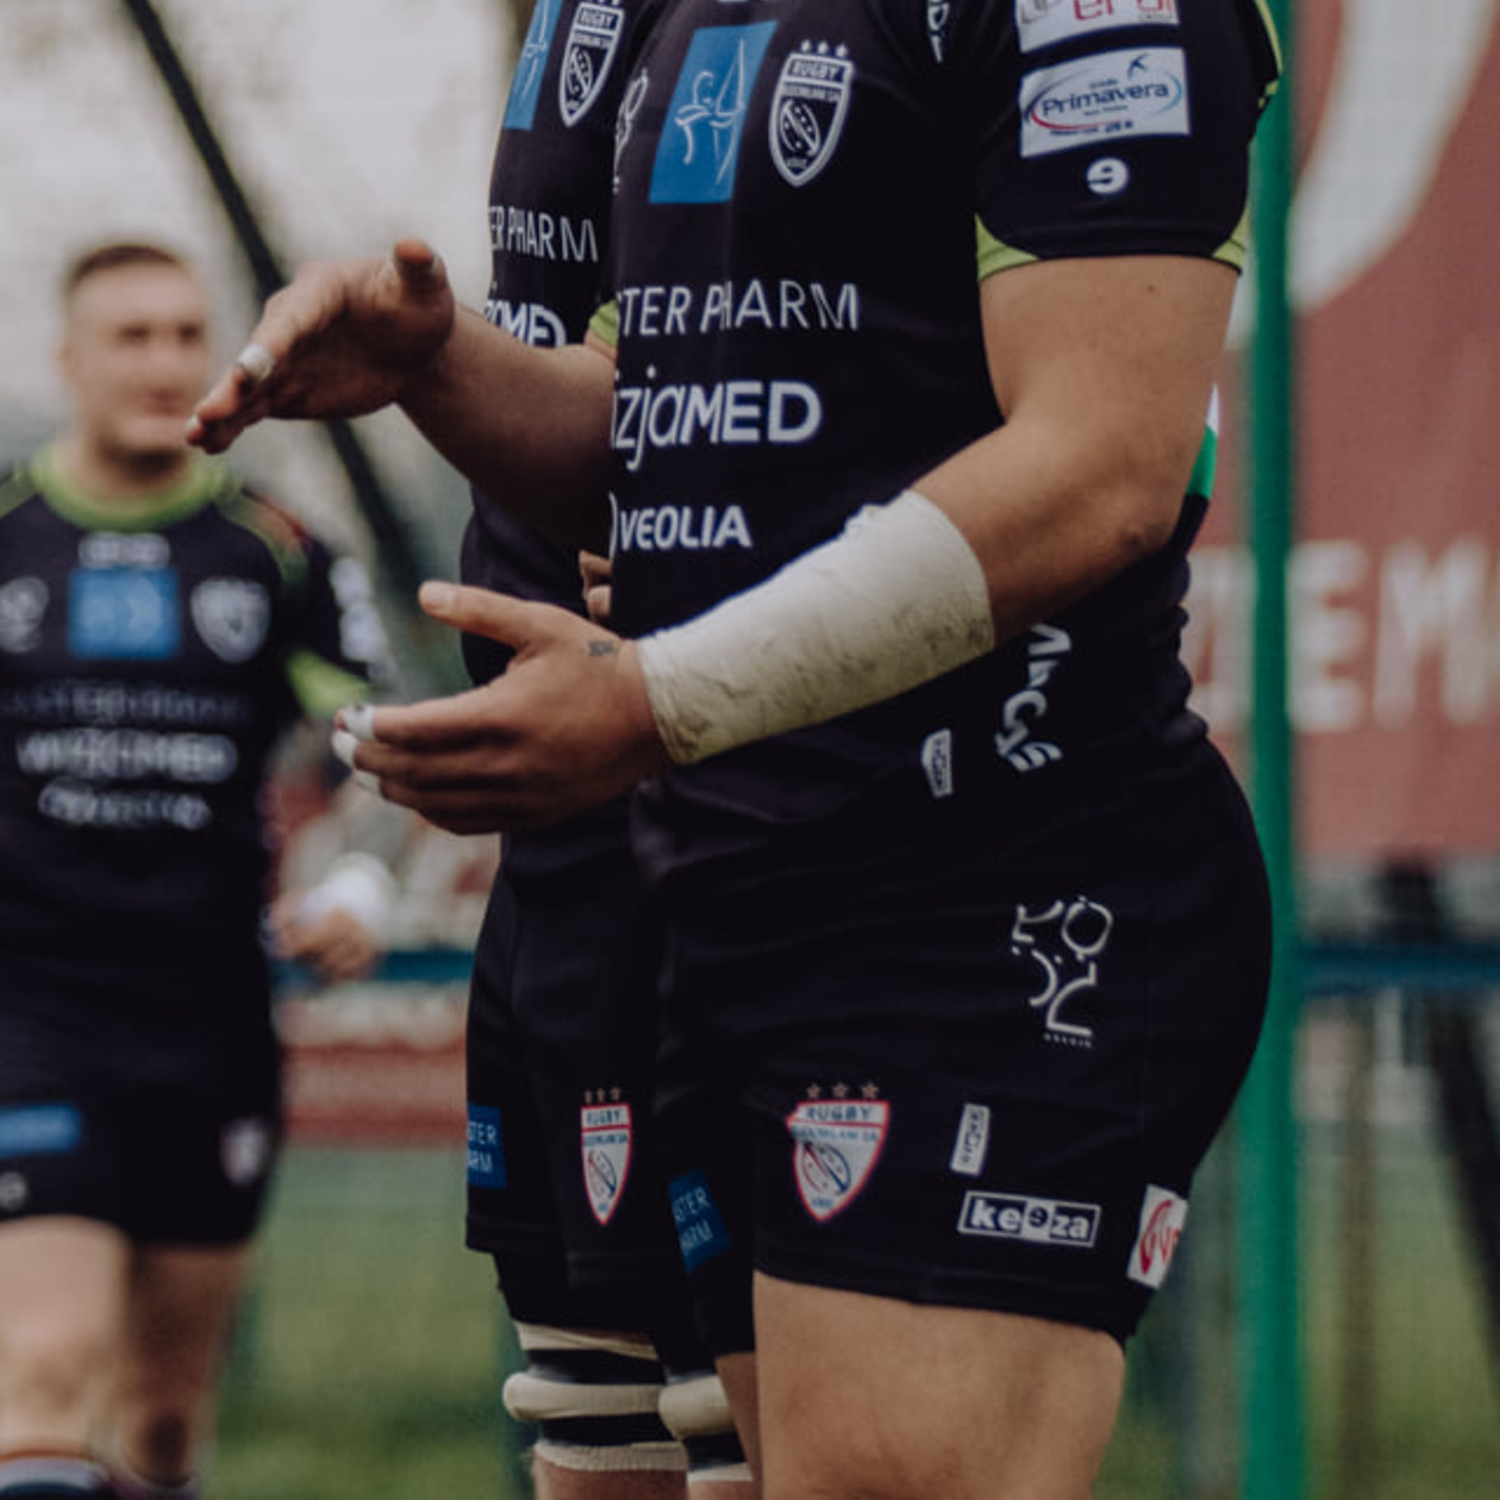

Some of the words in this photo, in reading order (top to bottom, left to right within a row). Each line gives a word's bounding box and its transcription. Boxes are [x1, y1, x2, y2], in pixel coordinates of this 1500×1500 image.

[1041, 82, 1170, 117] Primavera
[507, 207, 599, 263] PHARM
[617, 284, 691, 336] TER
[698, 278, 860, 335] PHARM
[619, 504, 754, 552] VEOLIA
[806, 1105, 874, 1122] RUGBY
